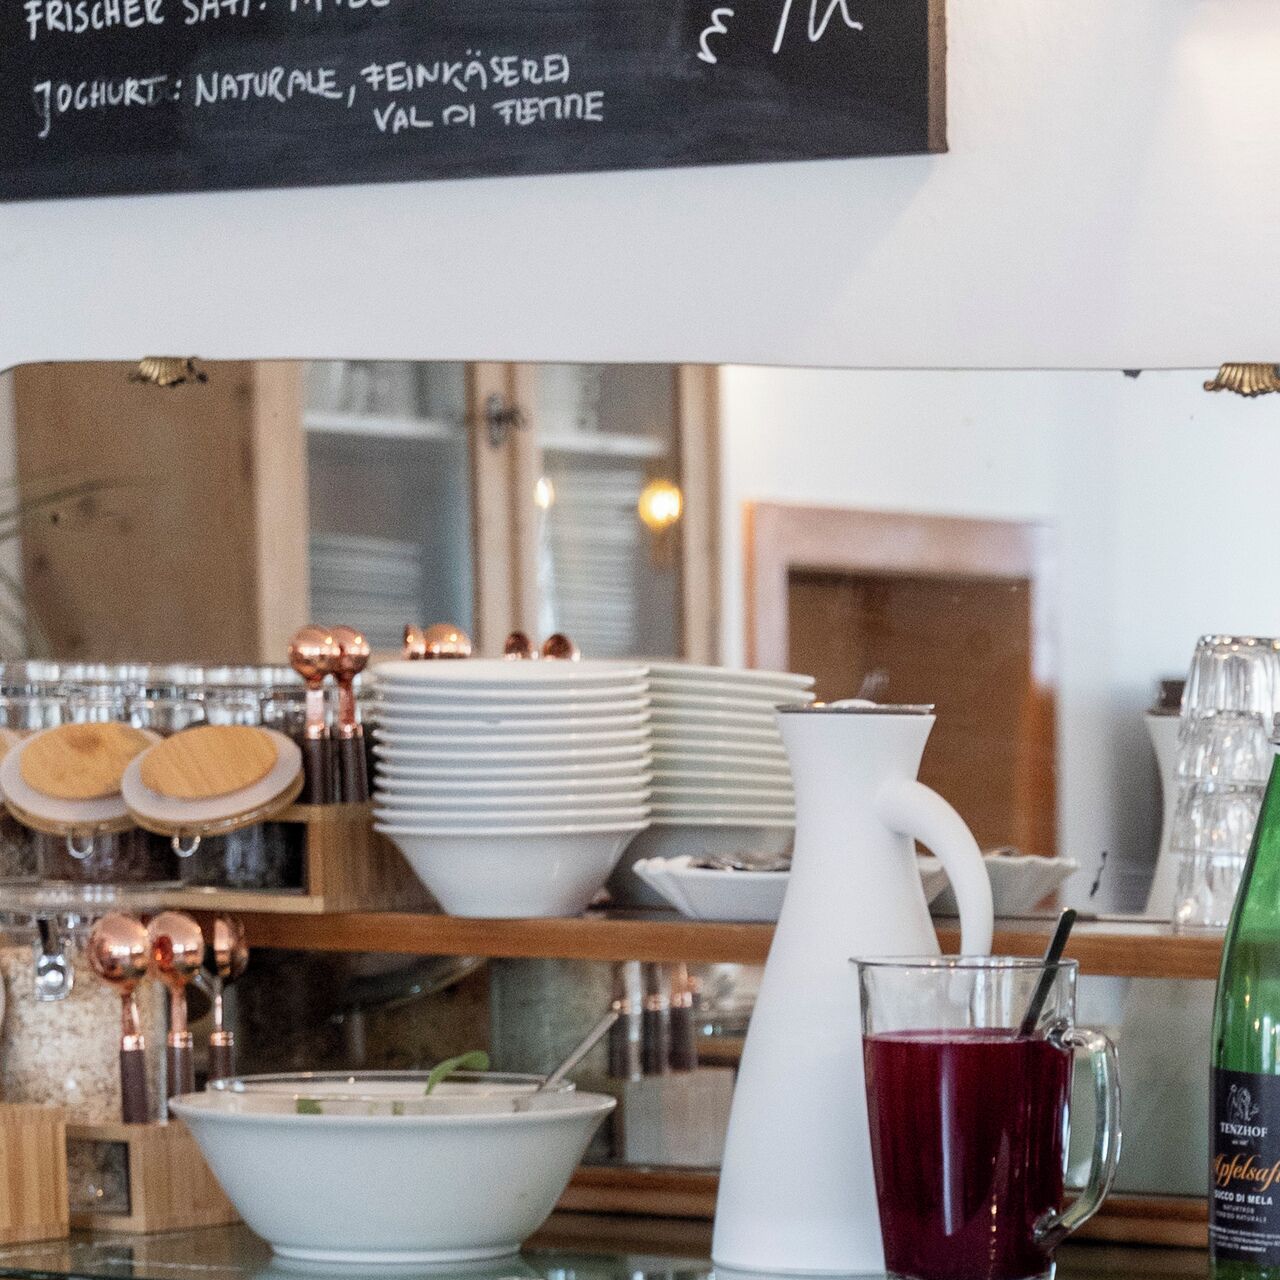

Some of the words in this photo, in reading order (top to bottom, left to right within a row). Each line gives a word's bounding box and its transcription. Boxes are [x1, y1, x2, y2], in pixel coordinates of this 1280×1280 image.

[23, 0, 165, 41] FRISCHER
[360, 48, 570, 93] FEINKÄSEREI
[373, 101, 434, 134] VAL
[1220, 1121, 1268, 1138] TENZHOF
[1214, 1189, 1235, 1201] SUCCO
[1235, 1193, 1246, 1203] DI
[1247, 1194, 1274, 1206] MELA
